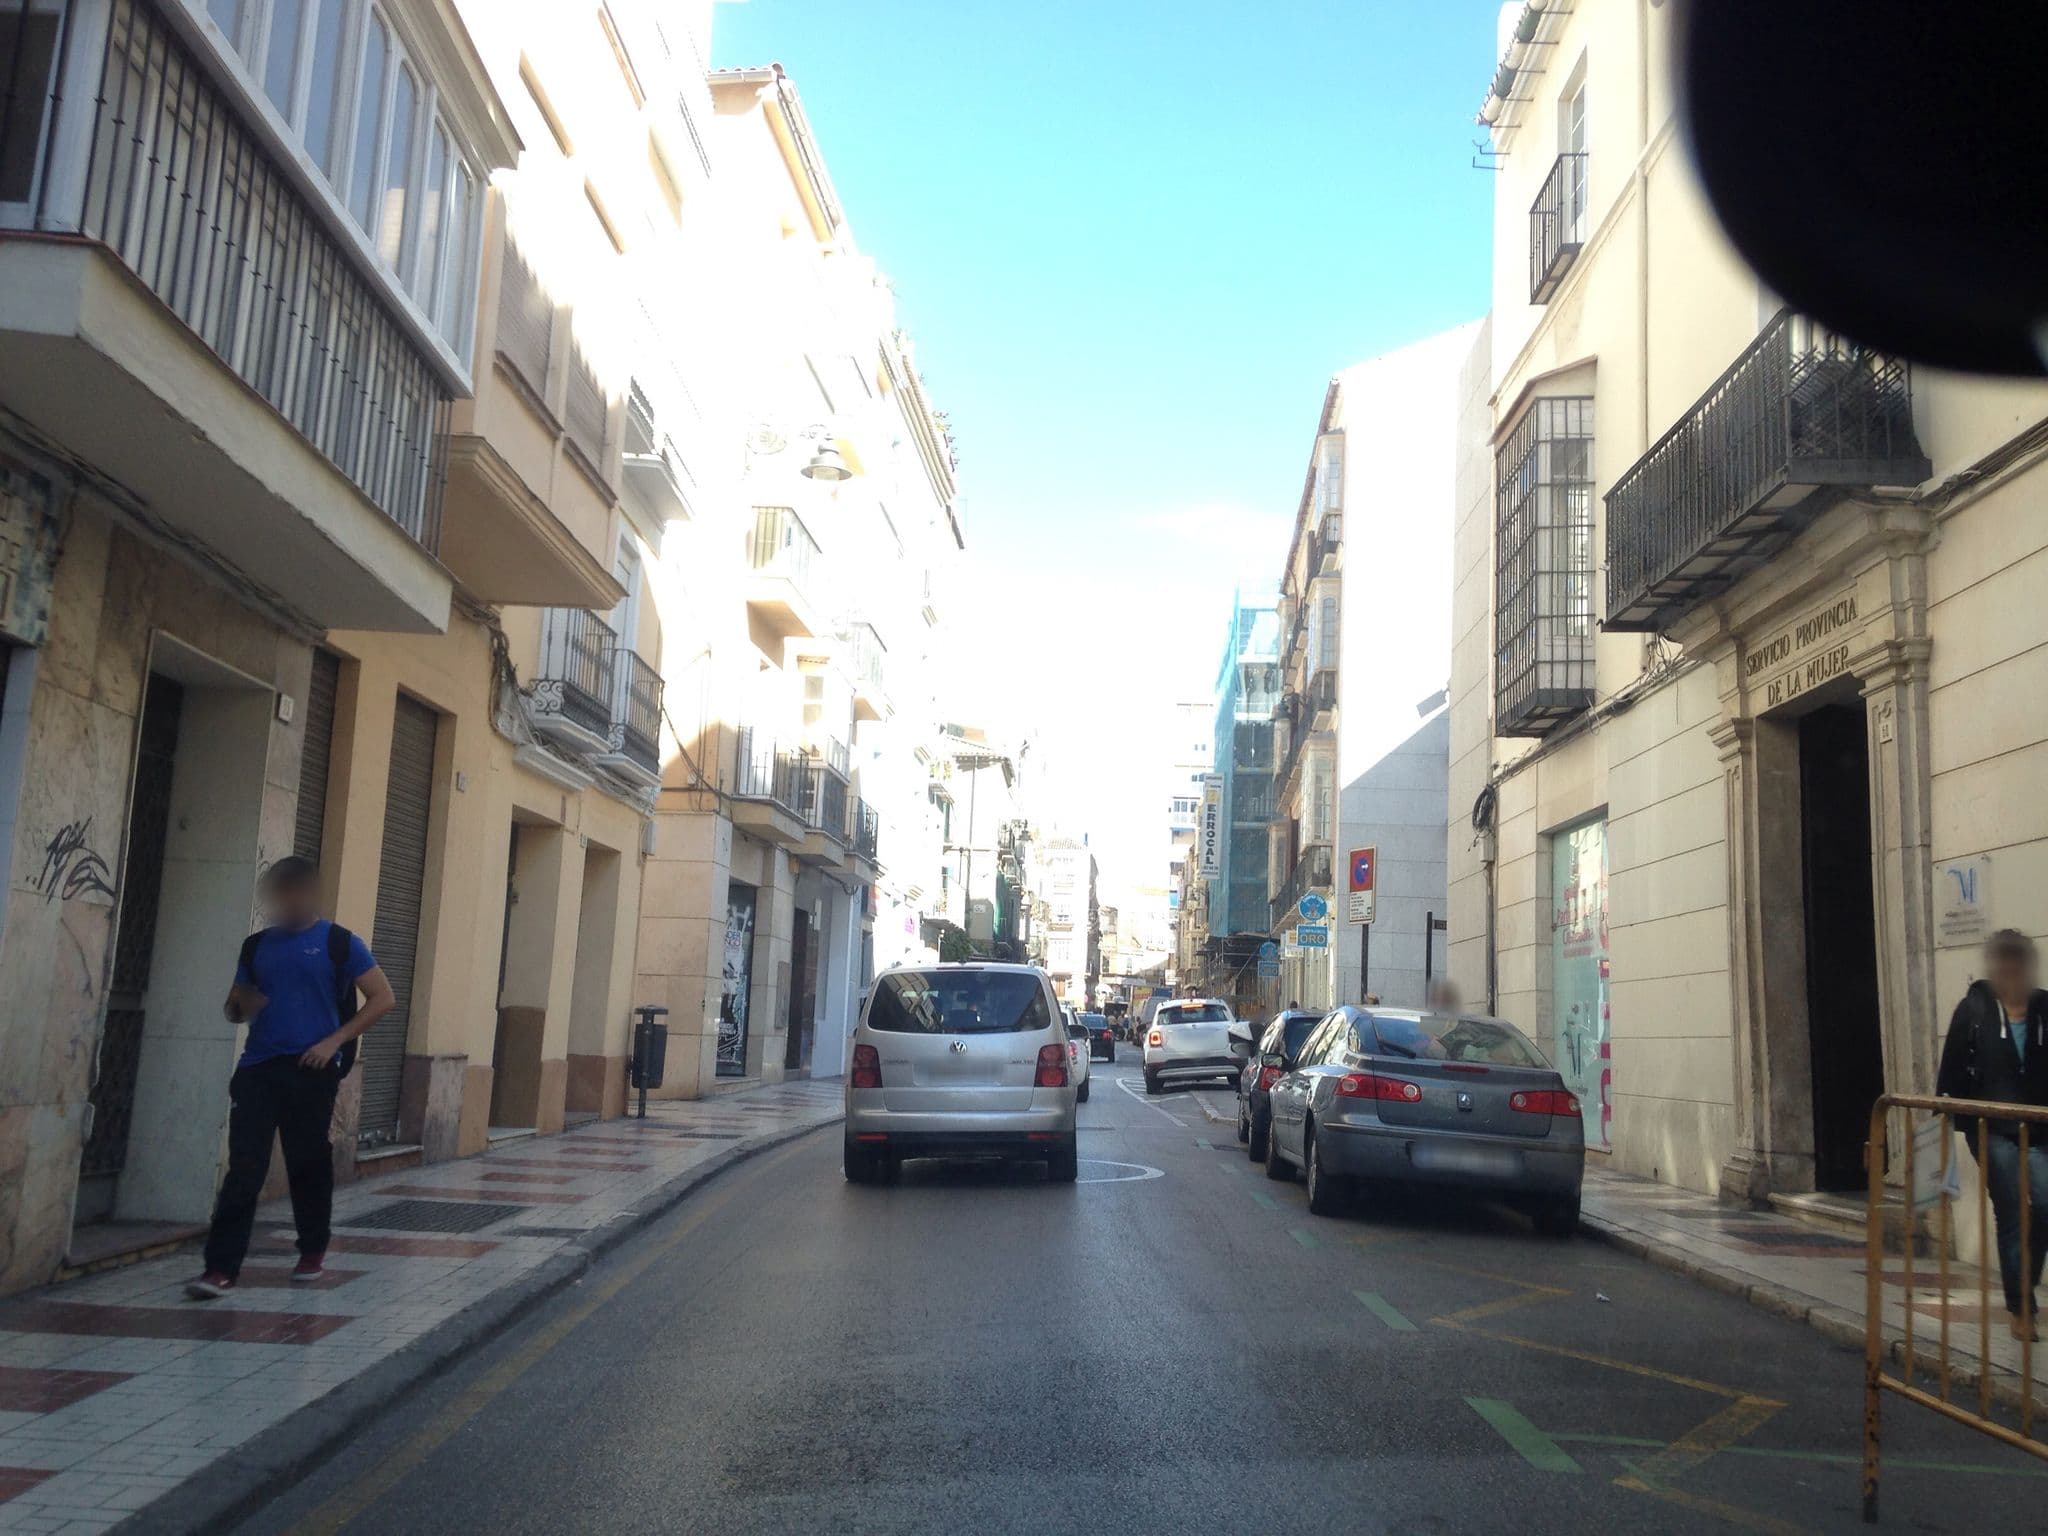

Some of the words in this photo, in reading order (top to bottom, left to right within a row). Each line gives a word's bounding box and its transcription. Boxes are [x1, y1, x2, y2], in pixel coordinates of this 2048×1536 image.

[1746, 634, 1790, 677] SERVICIO
[1767, 680, 1782, 707] DE
[1787, 671, 1802, 697] LA
[1806, 645, 1849, 688] MUJER
[1301, 934, 1326, 944] ORO
